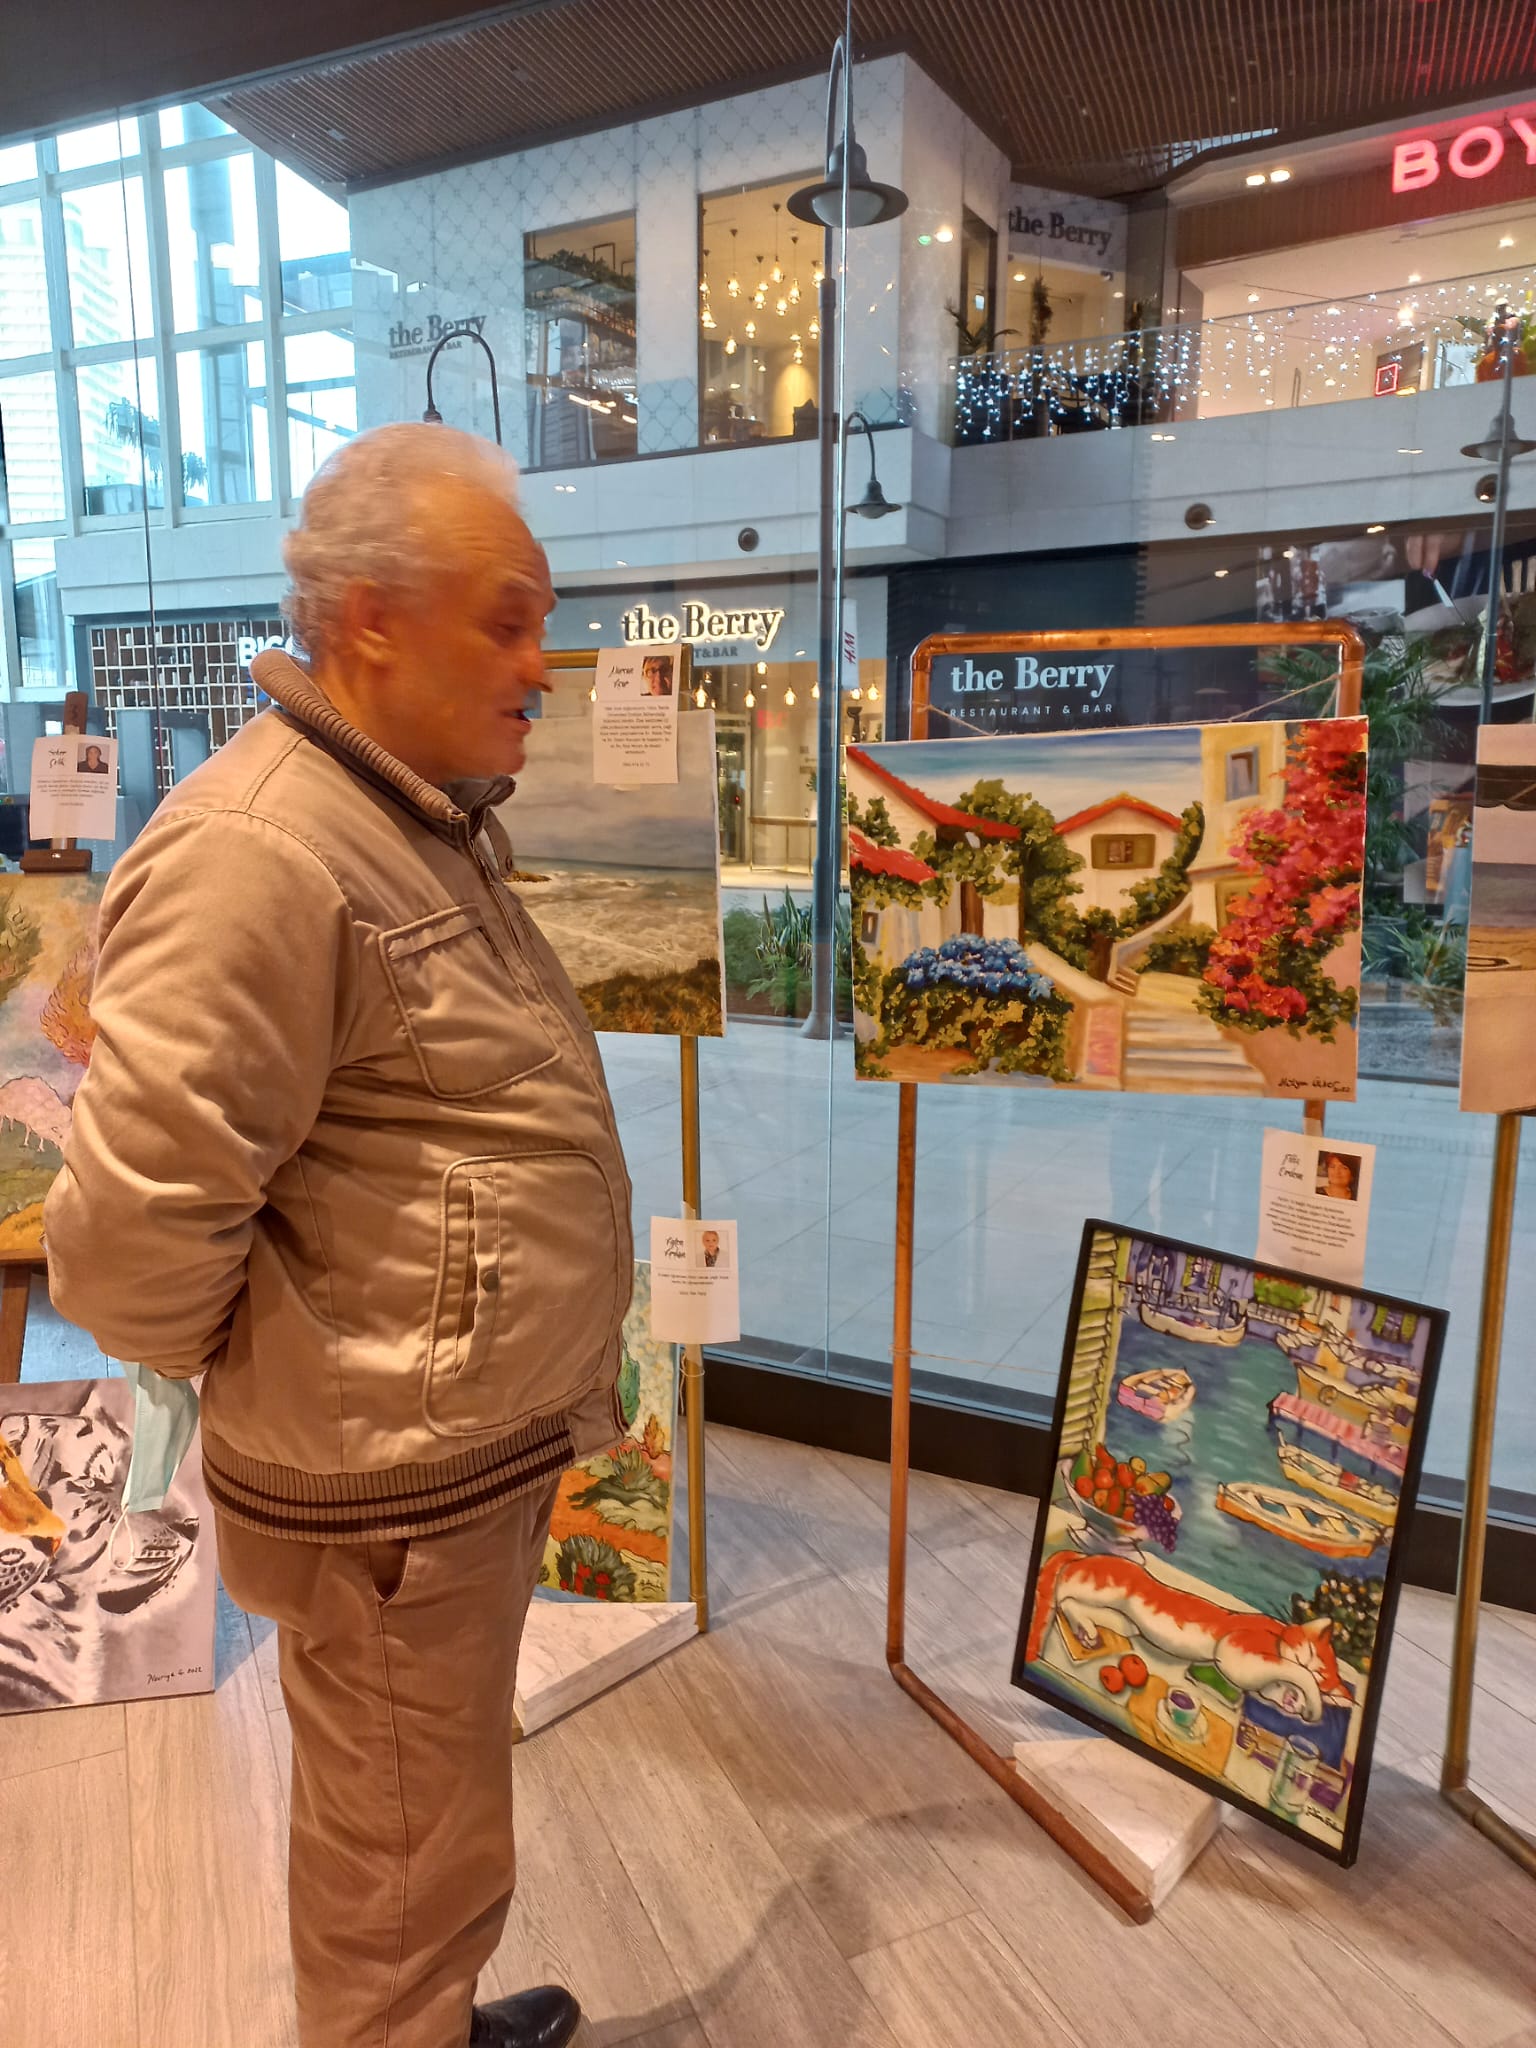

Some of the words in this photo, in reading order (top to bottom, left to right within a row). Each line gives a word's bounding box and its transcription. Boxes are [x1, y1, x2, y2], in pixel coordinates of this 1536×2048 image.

[1008, 206, 1044, 236] the
[1048, 212, 1112, 256] Berry
[388, 320, 423, 348] the
[427, 314, 487, 344] Berry
[621, 604, 678, 645] the
[681, 601, 786, 651] Berry
[951, 659, 1004, 692] the
[1014, 656, 1115, 698] Berry
[951, 705, 1051, 718] RESTAURANT
[1062, 705, 1071, 714] &
[1082, 704, 1113, 714] BAR
